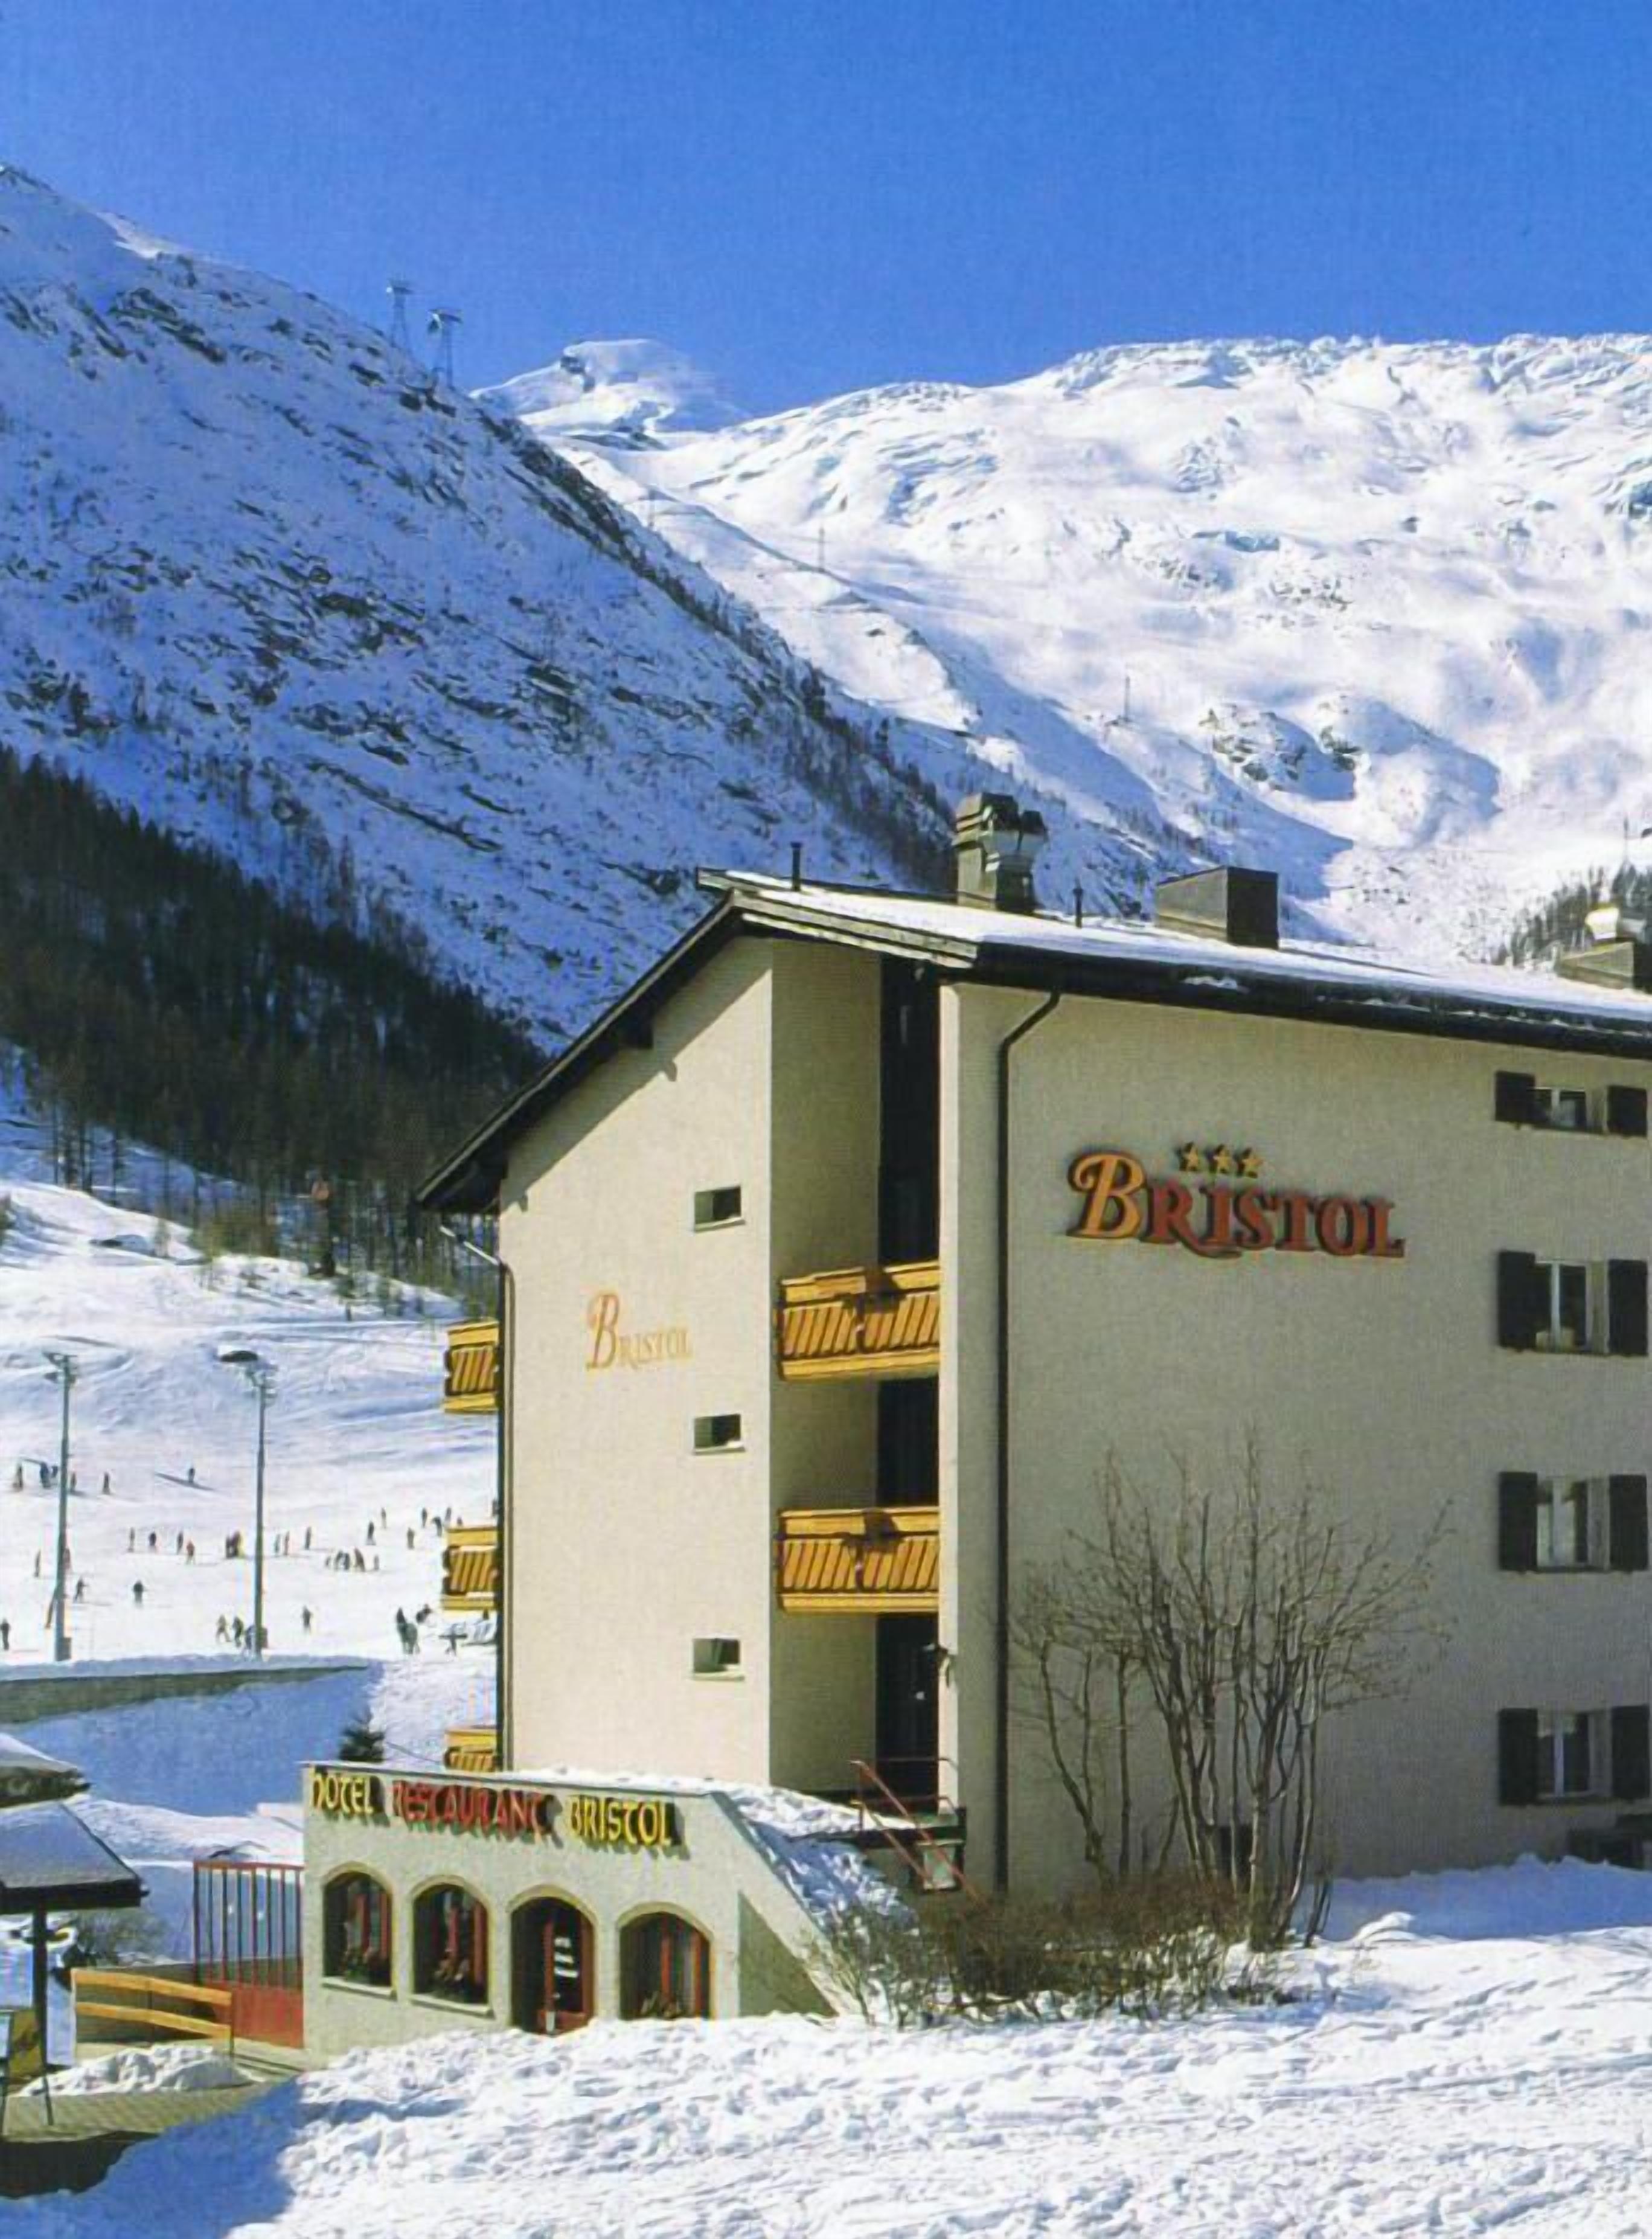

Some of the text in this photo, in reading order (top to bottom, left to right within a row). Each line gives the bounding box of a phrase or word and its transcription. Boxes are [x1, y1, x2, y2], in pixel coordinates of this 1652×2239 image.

[1067, 1150, 1405, 1258] BRISTOL
[586, 1292, 693, 1371] BRISTOL
[567, 1795, 672, 1848] BRISTOL
